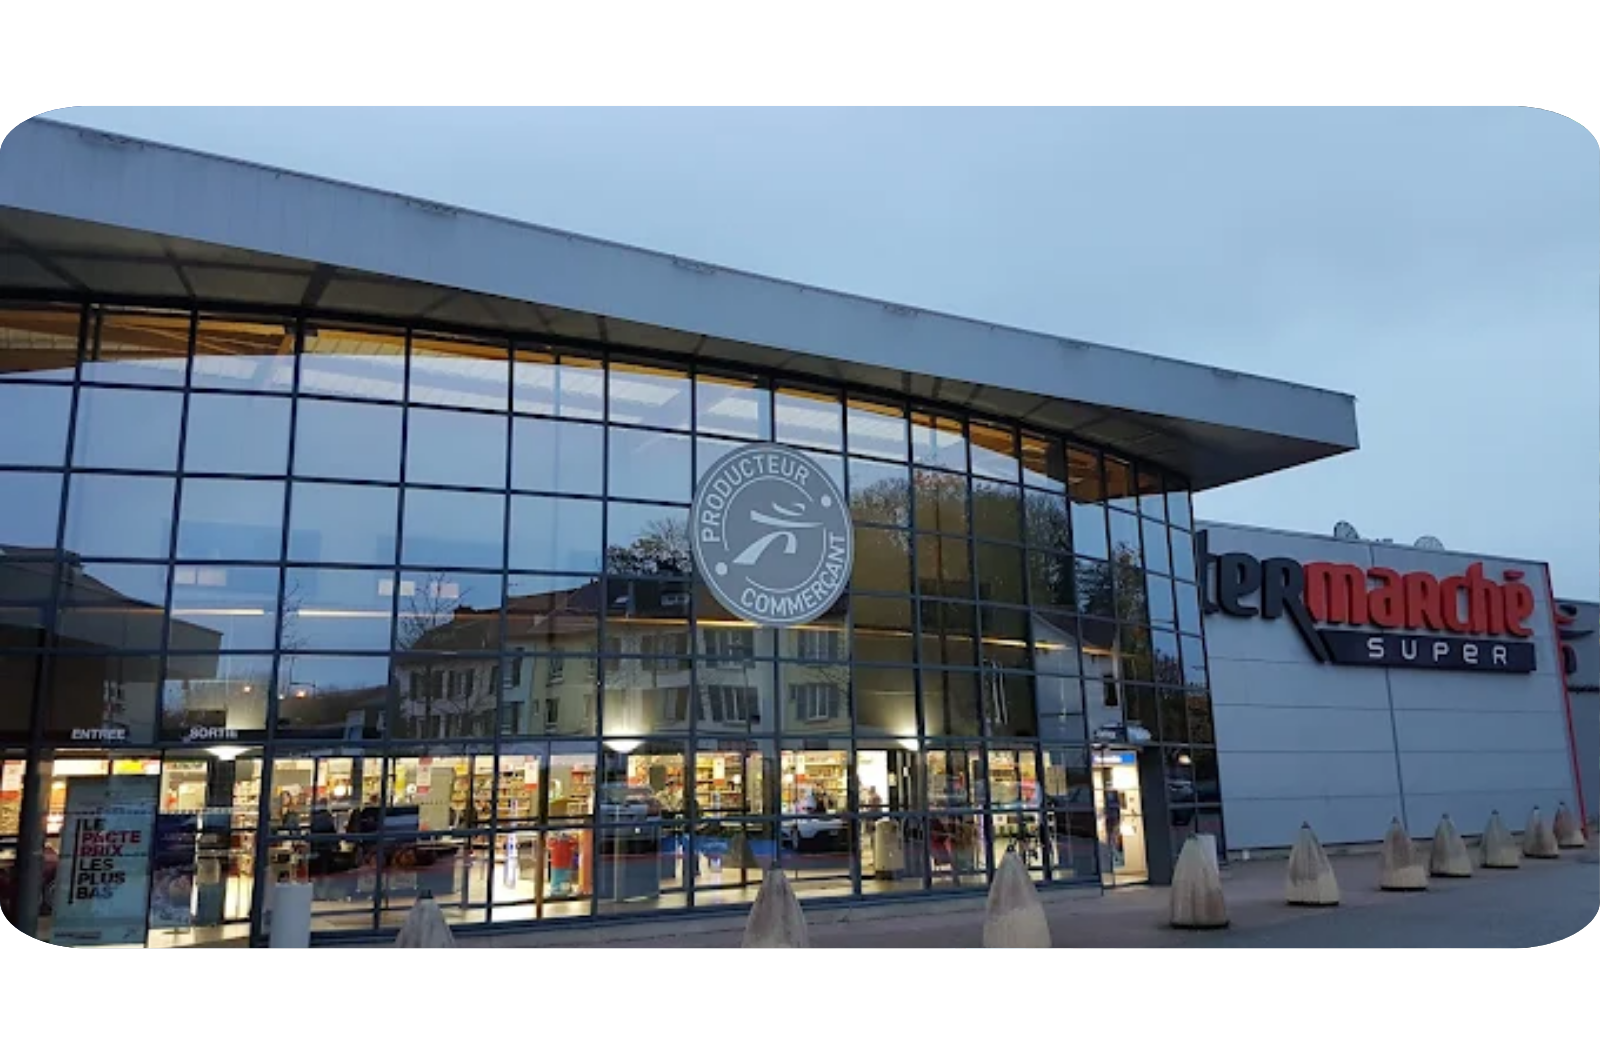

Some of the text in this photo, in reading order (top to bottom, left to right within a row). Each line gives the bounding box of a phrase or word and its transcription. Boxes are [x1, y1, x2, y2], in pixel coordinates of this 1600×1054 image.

[701, 454, 810, 543] PRODUCTEUR
[189, 727, 238, 739] SORTIE
[83, 818, 106, 831] LE
[81, 830, 142, 843] PACTE
[79, 844, 123, 857] PRIX
[79, 858, 114, 871] LES
[77, 871, 126, 885] PLUS
[76, 886, 113, 900] BAS
